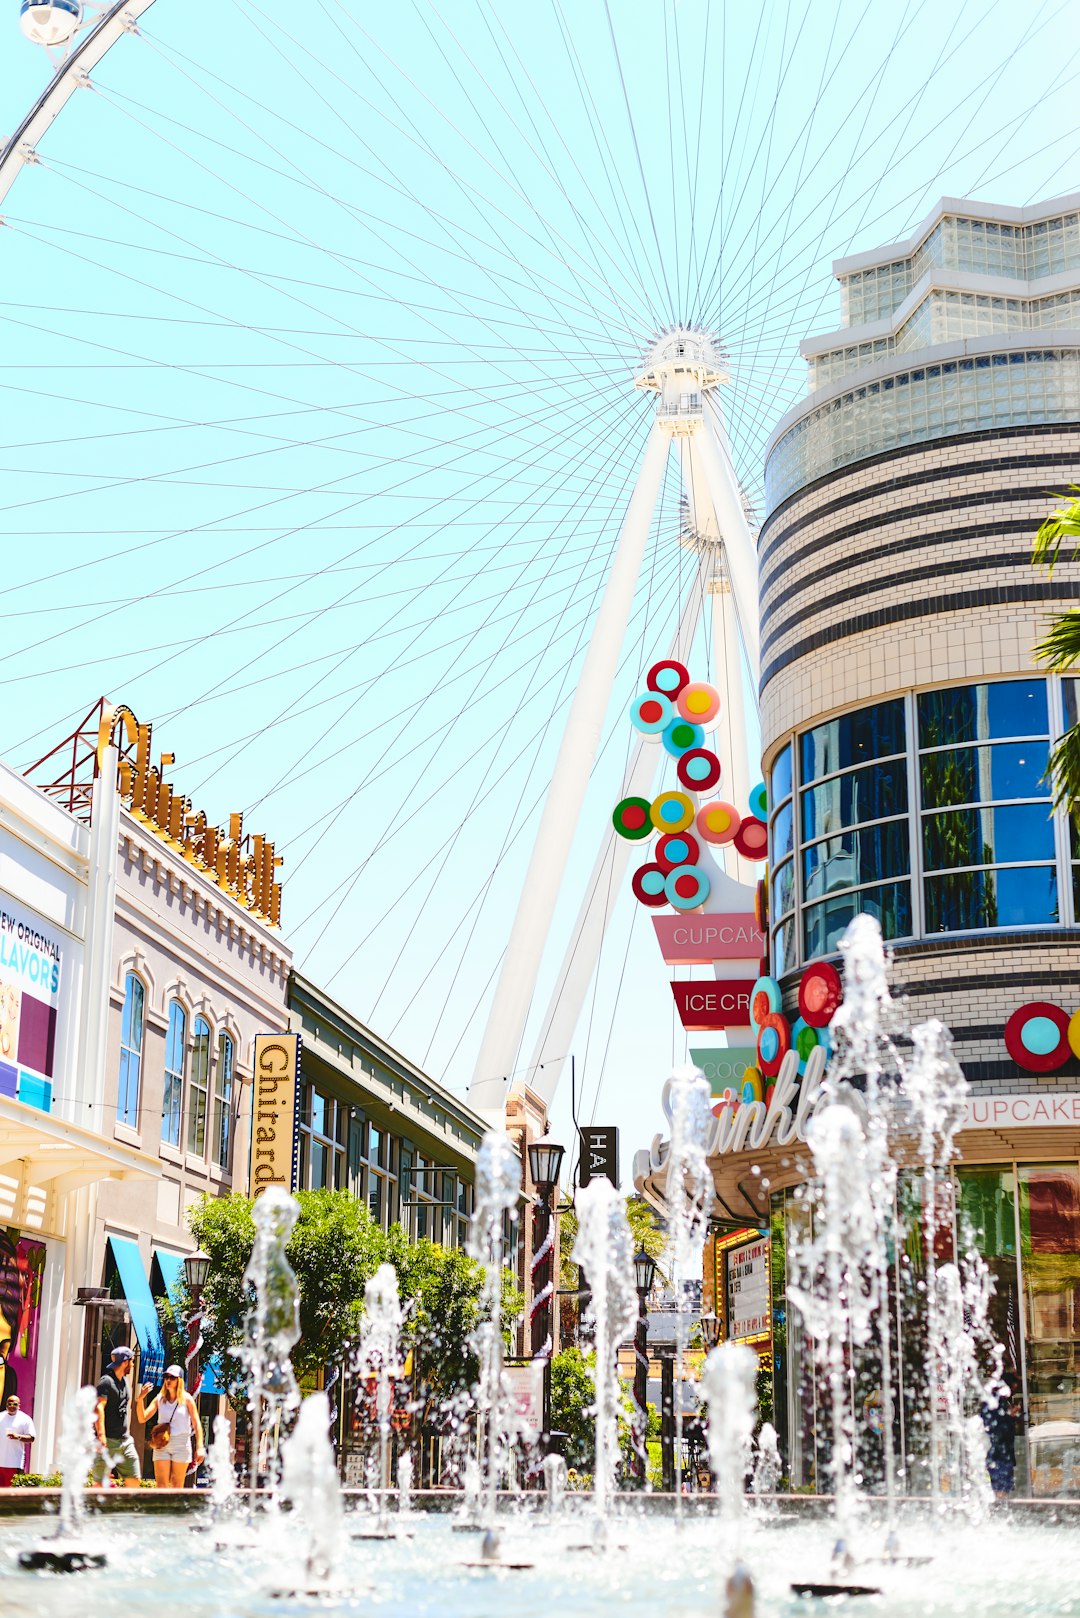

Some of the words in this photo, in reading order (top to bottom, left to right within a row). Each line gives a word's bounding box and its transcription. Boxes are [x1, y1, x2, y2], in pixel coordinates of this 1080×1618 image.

[0, 910, 16, 934] EW
[18, 922, 60, 962] ORIGINAL
[685, 994, 717, 1012] ICE
[720, 993, 750, 1011] CR
[253, 1044, 290, 1200] Ghirard
[962, 1097, 1080, 1124] UPCAKE
